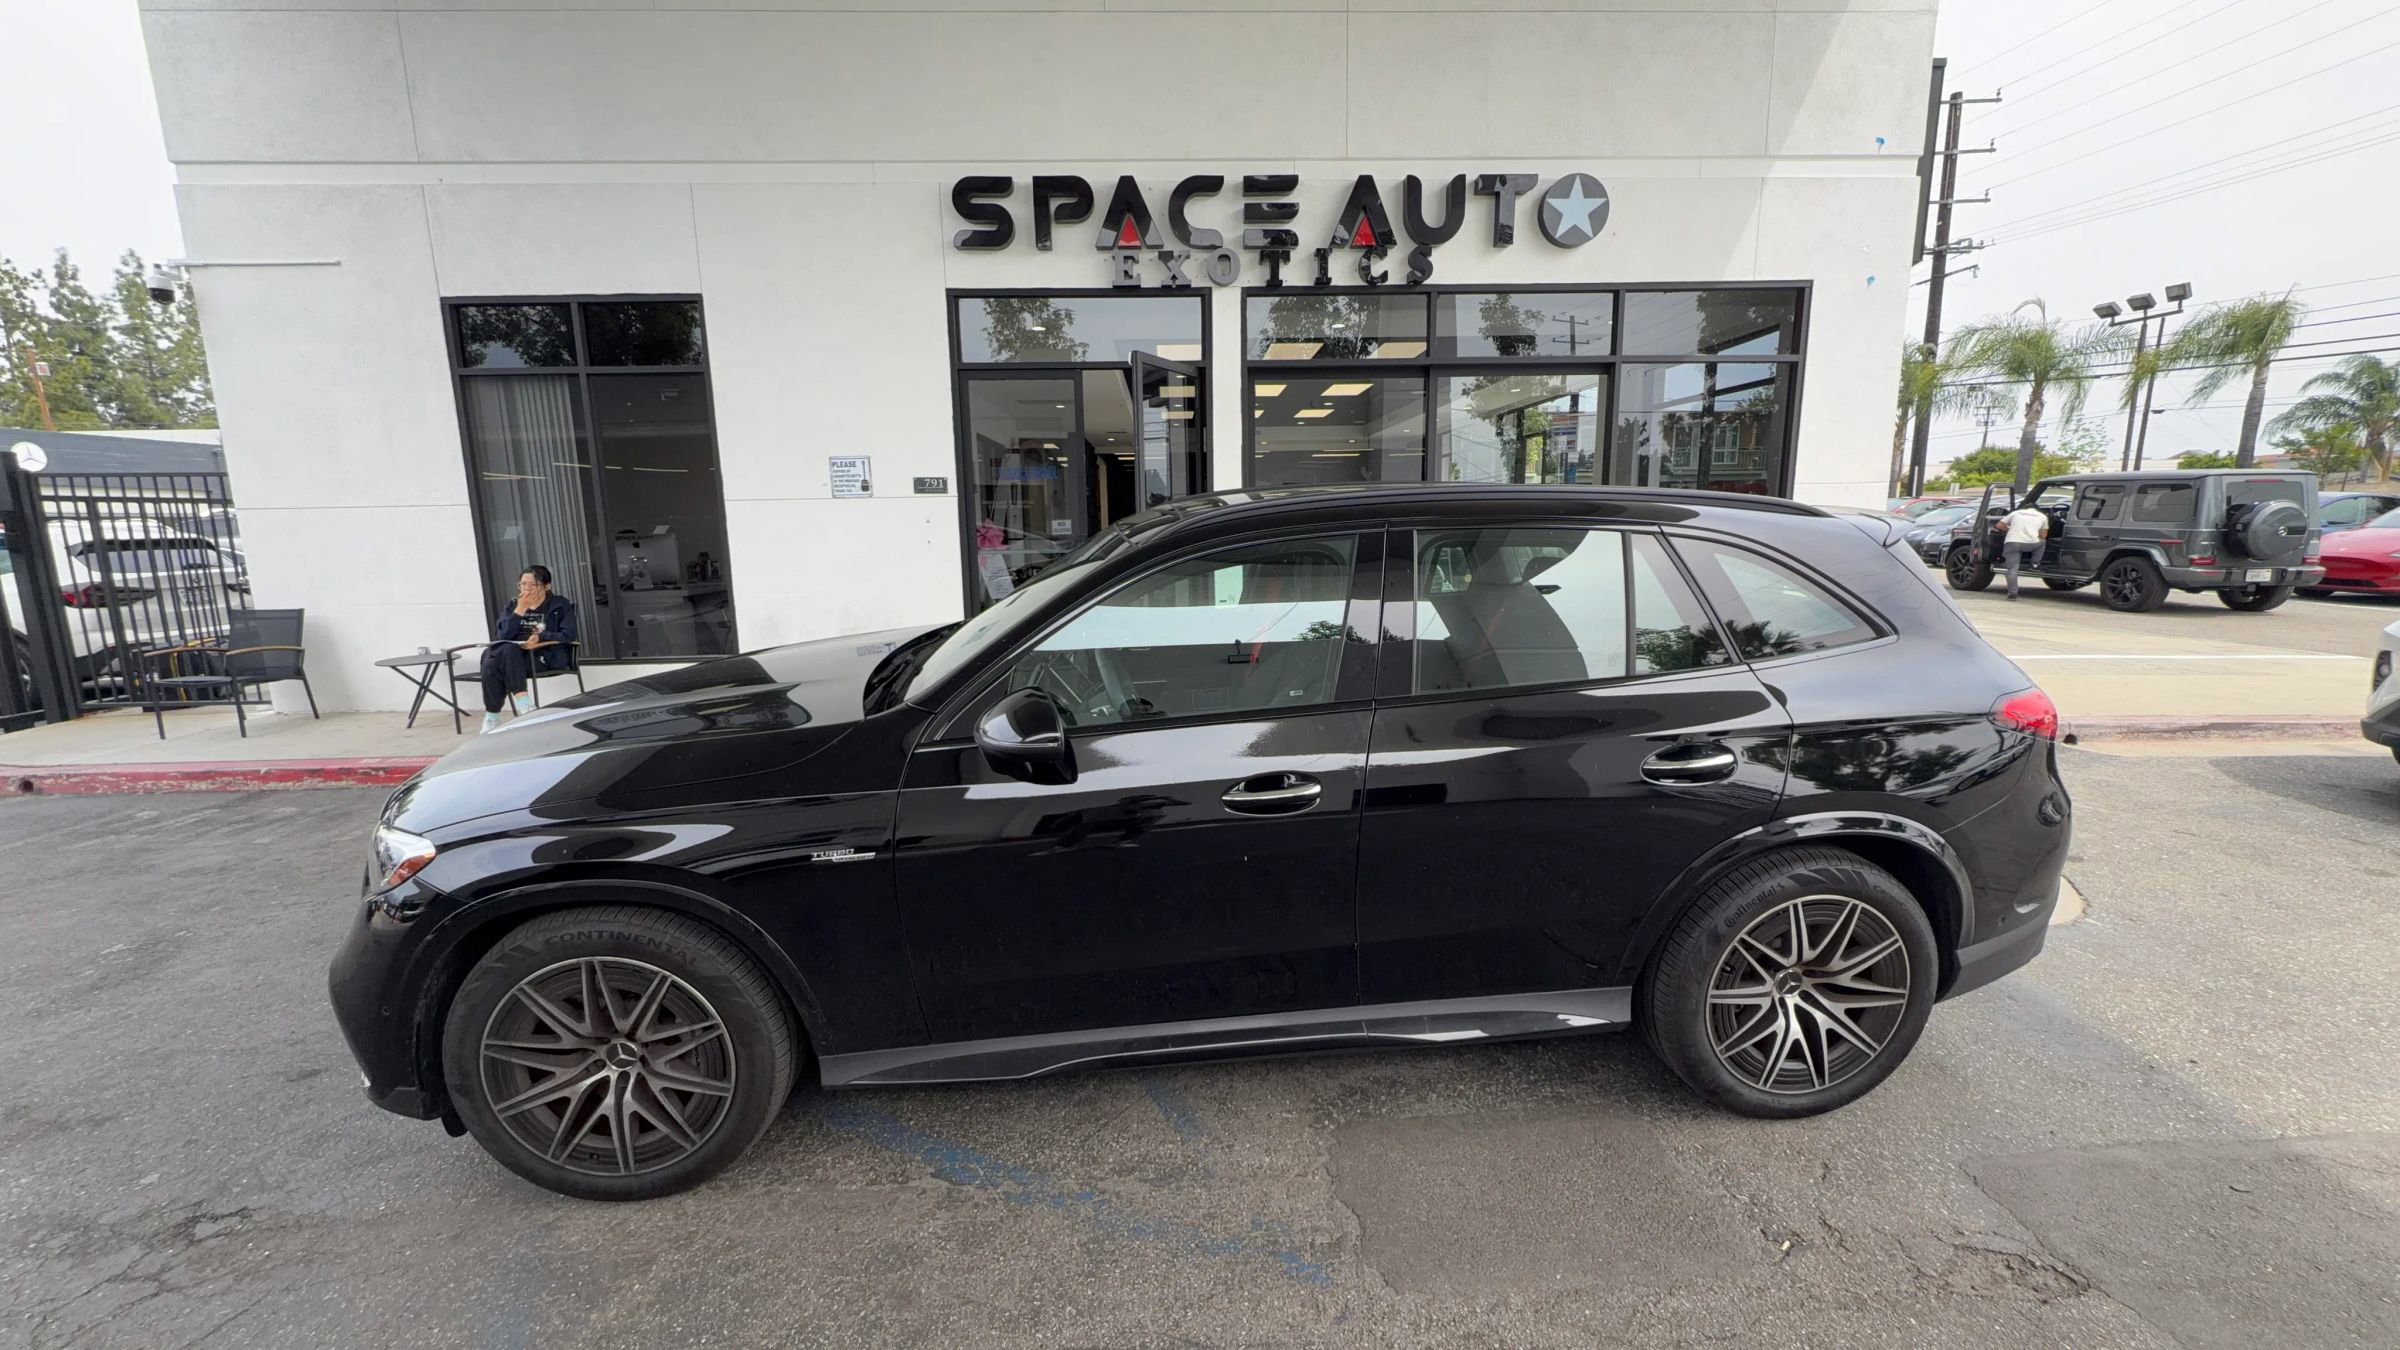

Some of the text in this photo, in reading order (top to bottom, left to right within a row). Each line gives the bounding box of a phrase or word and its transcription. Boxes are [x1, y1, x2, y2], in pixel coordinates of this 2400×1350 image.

[951, 174, 1300, 251] SPACE
[1110, 246, 1434, 287] EXOTICS
[924, 478, 944, 488] 791
[811, 848, 854, 858] TURBO
[544, 929, 698, 966] CONTINENTAL
